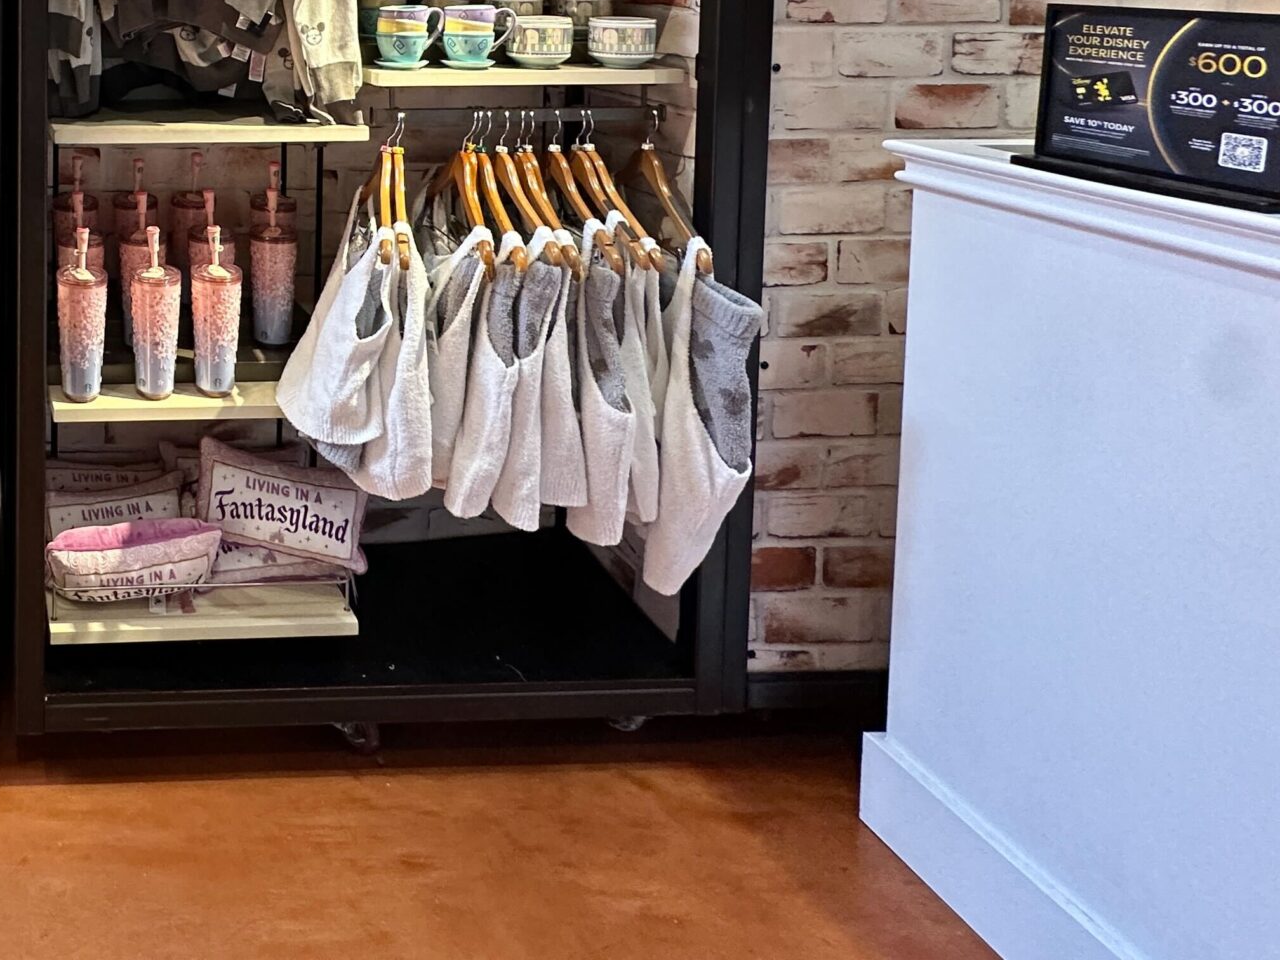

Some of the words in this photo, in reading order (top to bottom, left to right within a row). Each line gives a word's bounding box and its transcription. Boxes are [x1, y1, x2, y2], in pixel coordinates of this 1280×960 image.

[1082, 24, 1134, 37] ELEVATE
[1066, 34, 1100, 46] YOUR
[1103, 37, 1150, 50] DISNEY
[1068, 45, 1145, 61] EXPERIENCE
[1188, 51, 1267, 78] $600
[1170, 90, 1218, 108] $300
[1233, 97, 1280, 116] $300
[1063, 115, 1086, 126] SAVE
[1103, 121, 1135, 133] TODAY
[72, 472, 111, 483] LIVING
[115, 473, 129, 483] IN
[246, 475, 290, 498] LIVING
[295, 487, 309, 502] IN
[314, 492, 323, 505] A
[81, 505, 124, 521] LIVING
[127, 502, 141, 515] IN
[145, 500, 153, 512] A
[214, 487, 349, 544] Fantasyland
[99, 574, 145, 587] LIVING
[149, 570, 163, 583] IN
[168, 568, 177, 580] A
